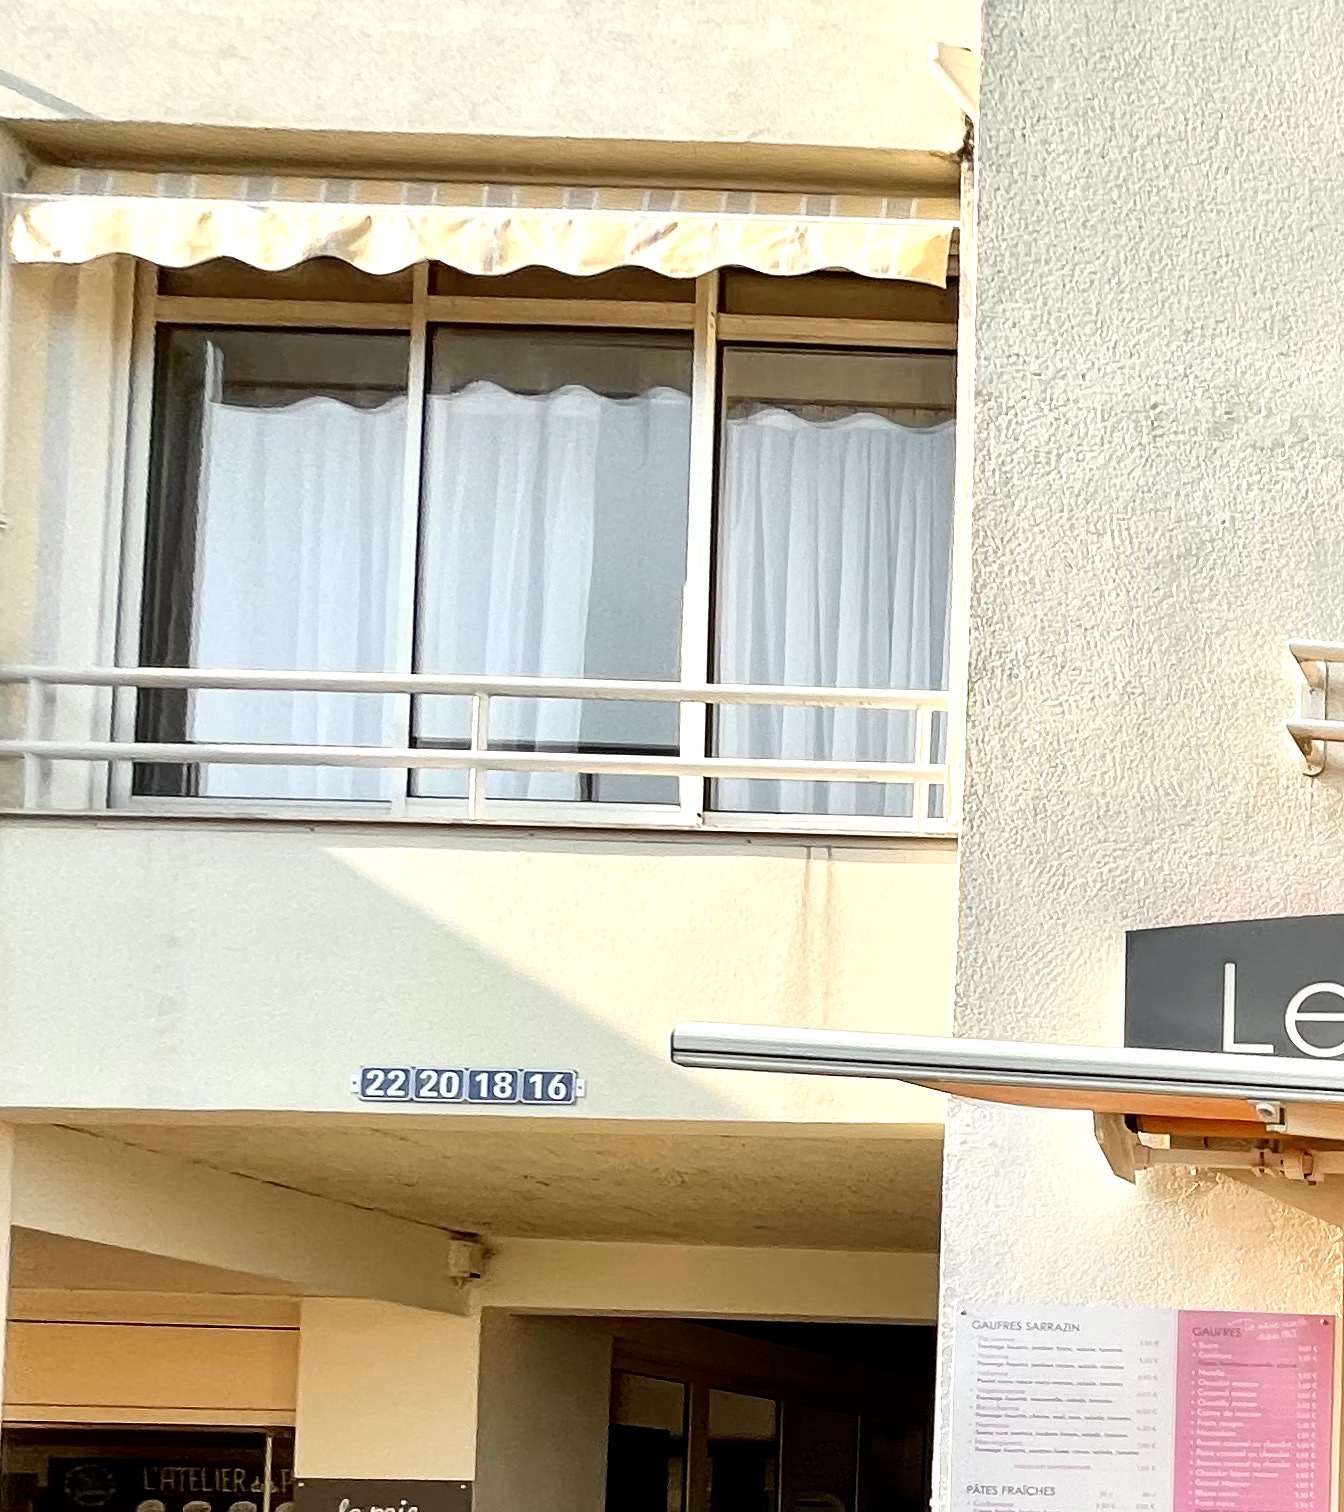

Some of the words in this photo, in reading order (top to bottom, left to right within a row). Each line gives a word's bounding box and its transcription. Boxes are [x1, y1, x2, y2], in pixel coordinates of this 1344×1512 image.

[366, 1070, 406, 1097] 22
[418, 1071, 460, 1099] 20
[475, 1072, 513, 1099] 18
[529, 1073, 567, 1100] 16
[972, 1320, 1022, 1331] GAUFRES
[1026, 1322, 1081, 1332] SARRAZIN
[1192, 1327, 1242, 1337] GAUFRES
[966, 1485, 998, 1496] PÂTES
[1001, 1485, 1056, 1496] FRAÎCHES
